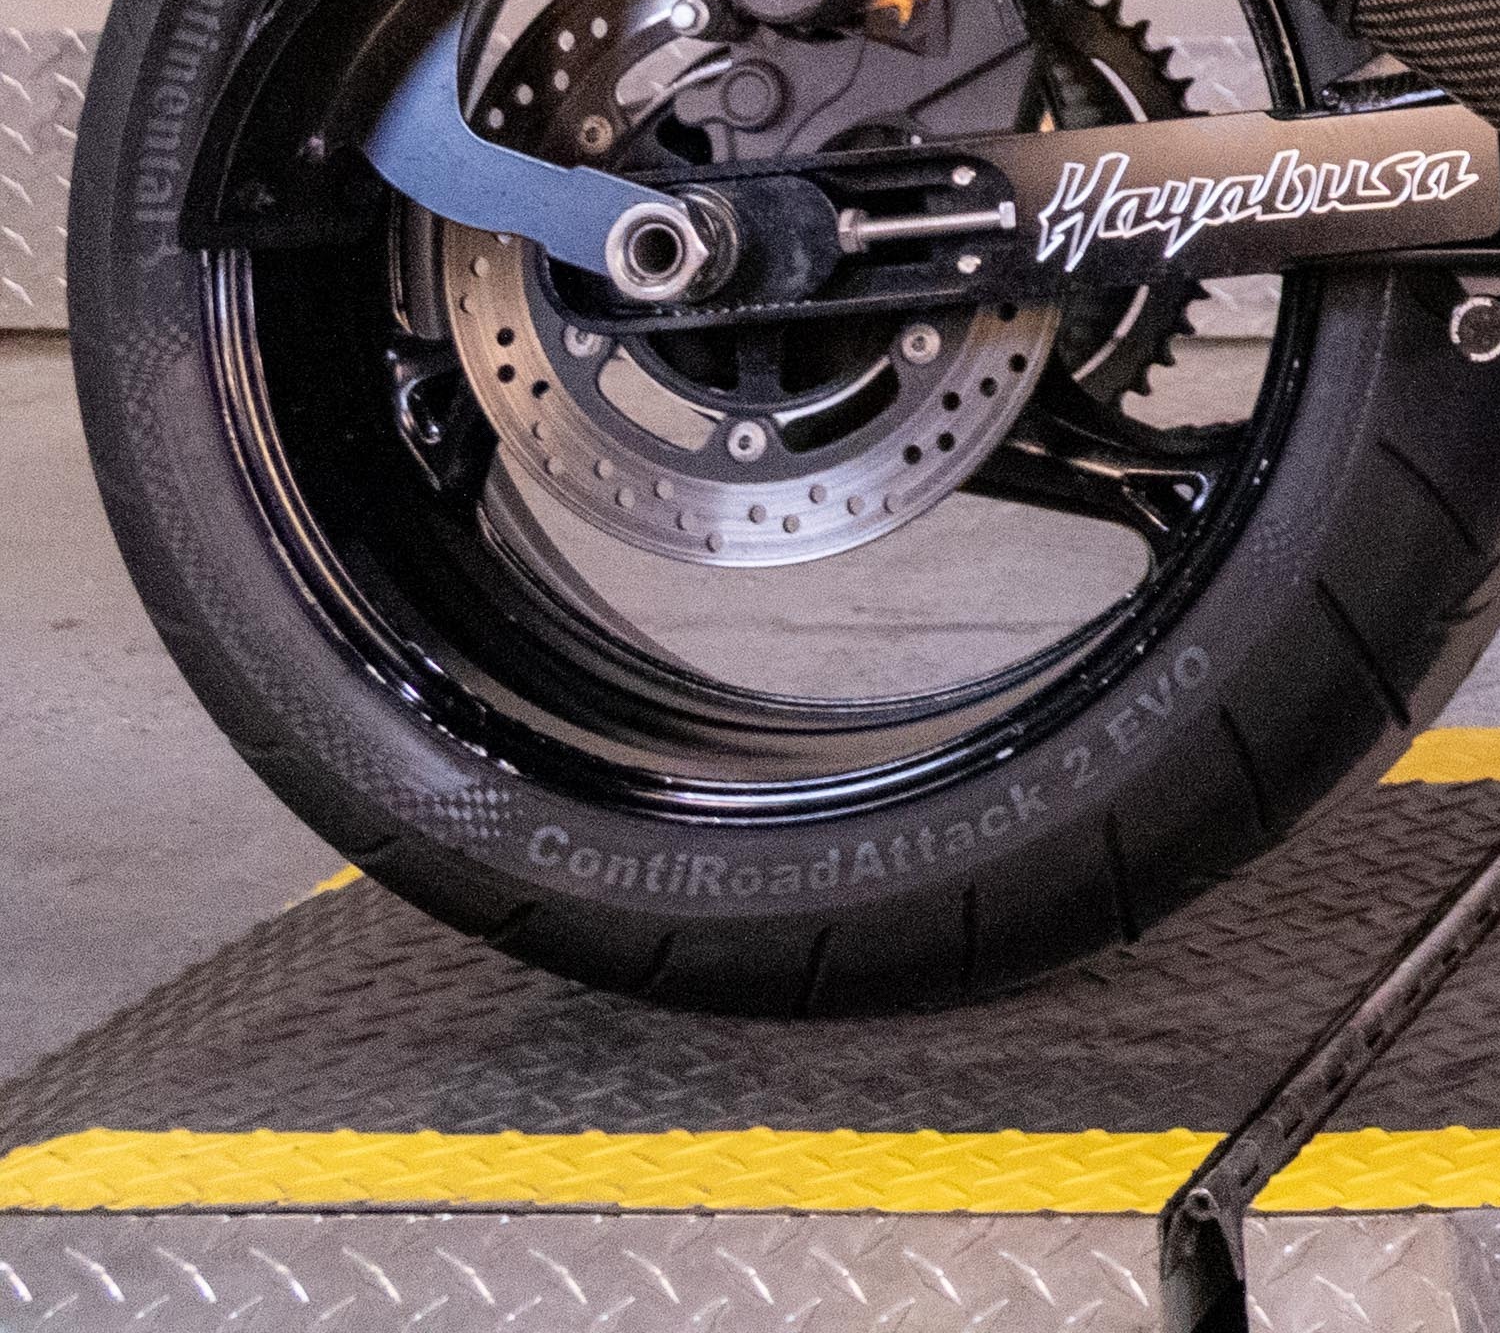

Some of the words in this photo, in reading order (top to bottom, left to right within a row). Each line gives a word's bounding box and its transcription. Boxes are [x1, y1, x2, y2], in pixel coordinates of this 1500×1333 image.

[1036, 148, 1480, 273] Hayabusa
[526, 779, 1052, 902] ContiRoadAttack
[1062, 745, 1096, 786] 2
[1105, 643, 1211, 753] EVO
